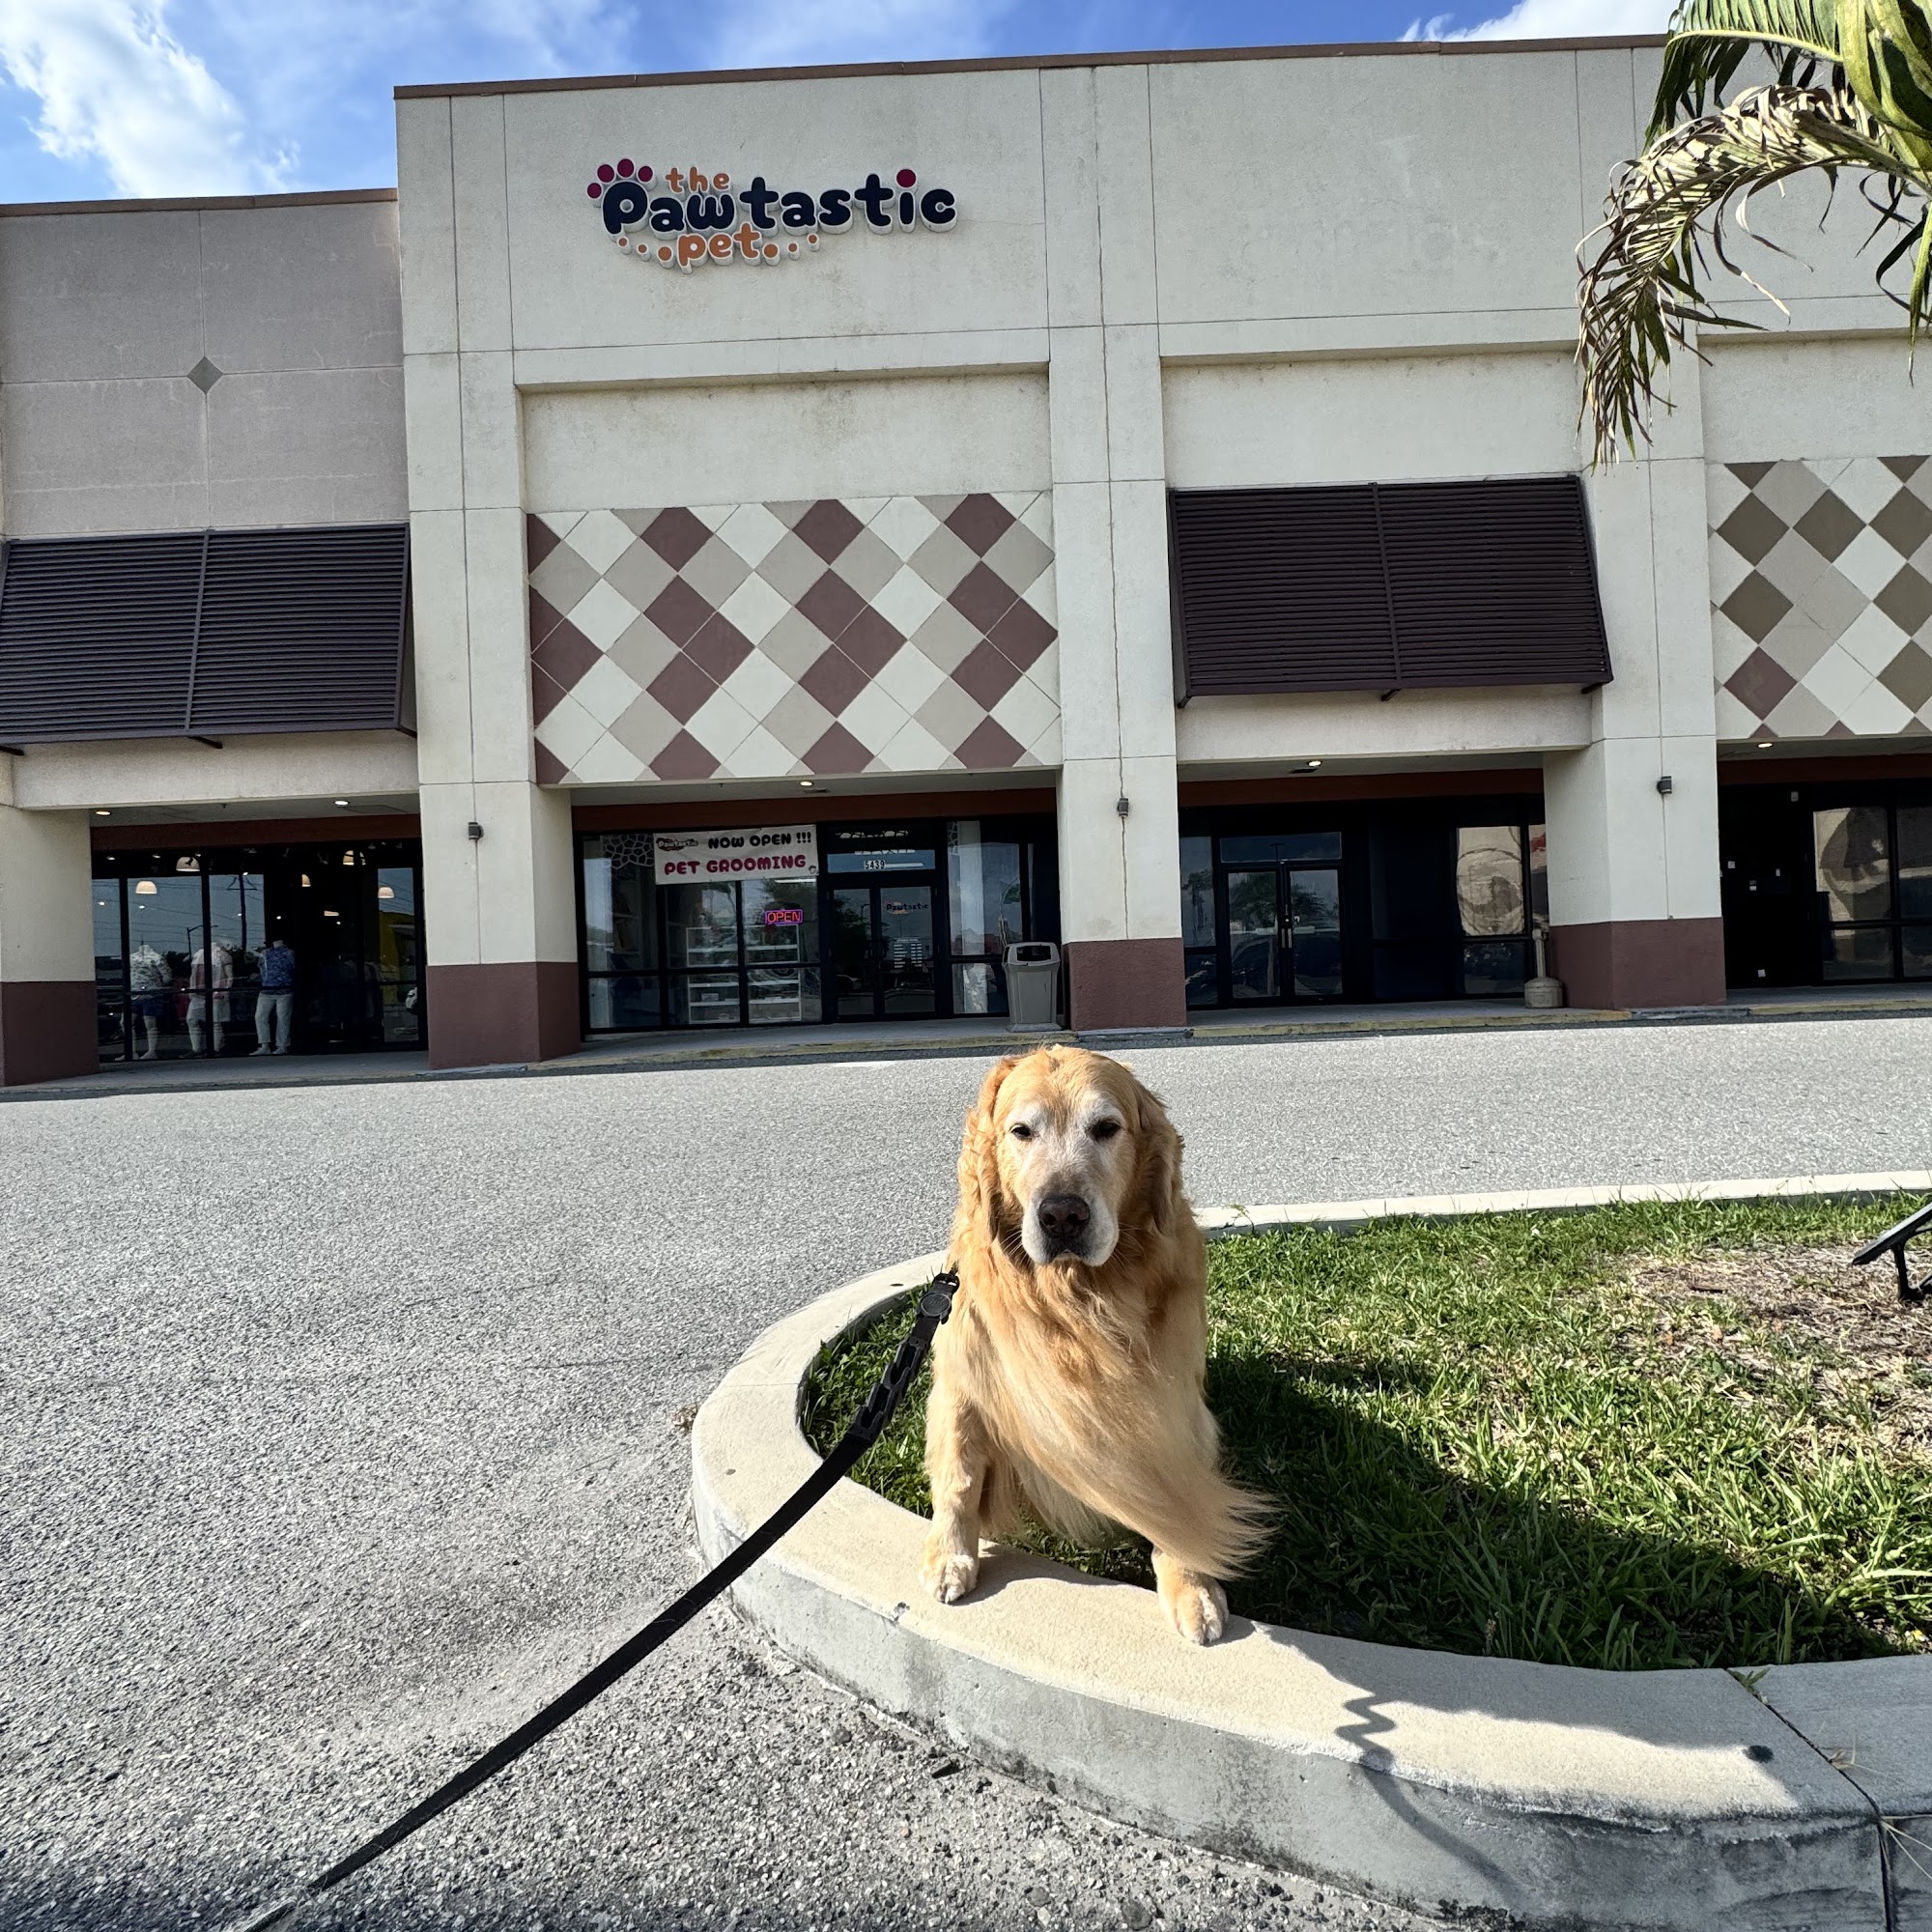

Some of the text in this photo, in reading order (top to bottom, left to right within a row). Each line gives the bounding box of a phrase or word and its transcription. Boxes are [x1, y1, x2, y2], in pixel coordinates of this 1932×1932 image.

[665, 166, 730, 193] the
[602, 168, 957, 236] Pawtastic
[677, 222, 761, 268] pet
[708, 836, 745, 850] NOW
[750, 832, 792, 847] OPEN
[665, 854, 807, 876] PET GROOMING
[865, 860, 885, 869] 5439
[767, 912, 801, 923] OPEN
